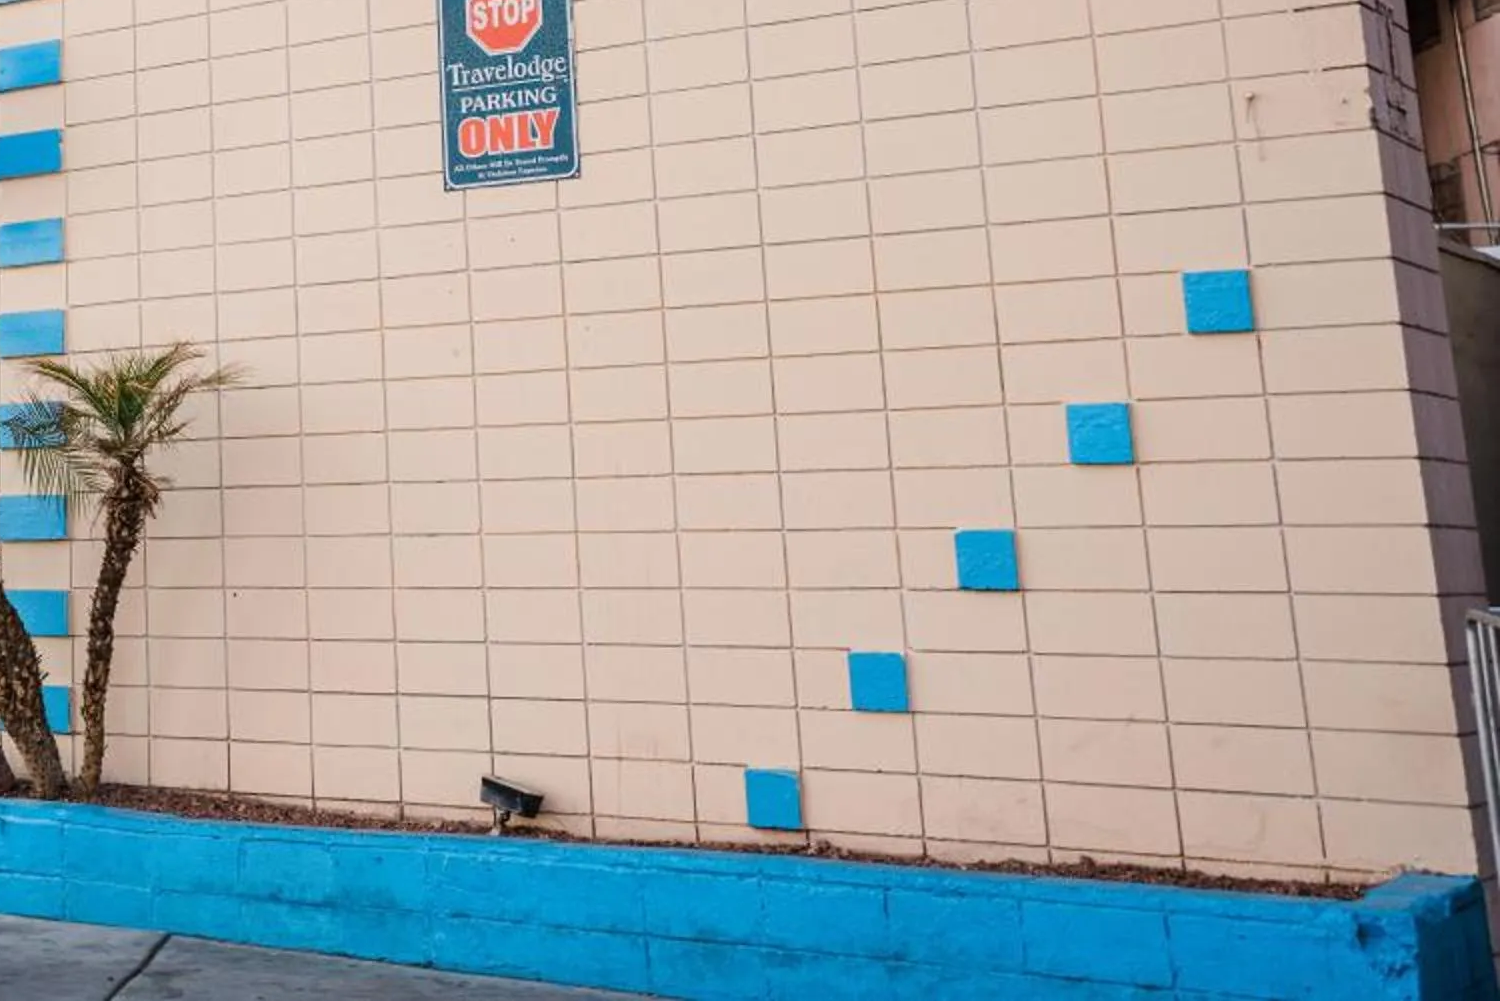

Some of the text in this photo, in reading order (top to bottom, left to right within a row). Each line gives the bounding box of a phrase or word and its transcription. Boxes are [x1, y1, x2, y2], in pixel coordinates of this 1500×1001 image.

[446, 55, 567, 87] Travelodge
[460, 86, 557, 114] PARKING
[457, 107, 561, 158] ONLY
